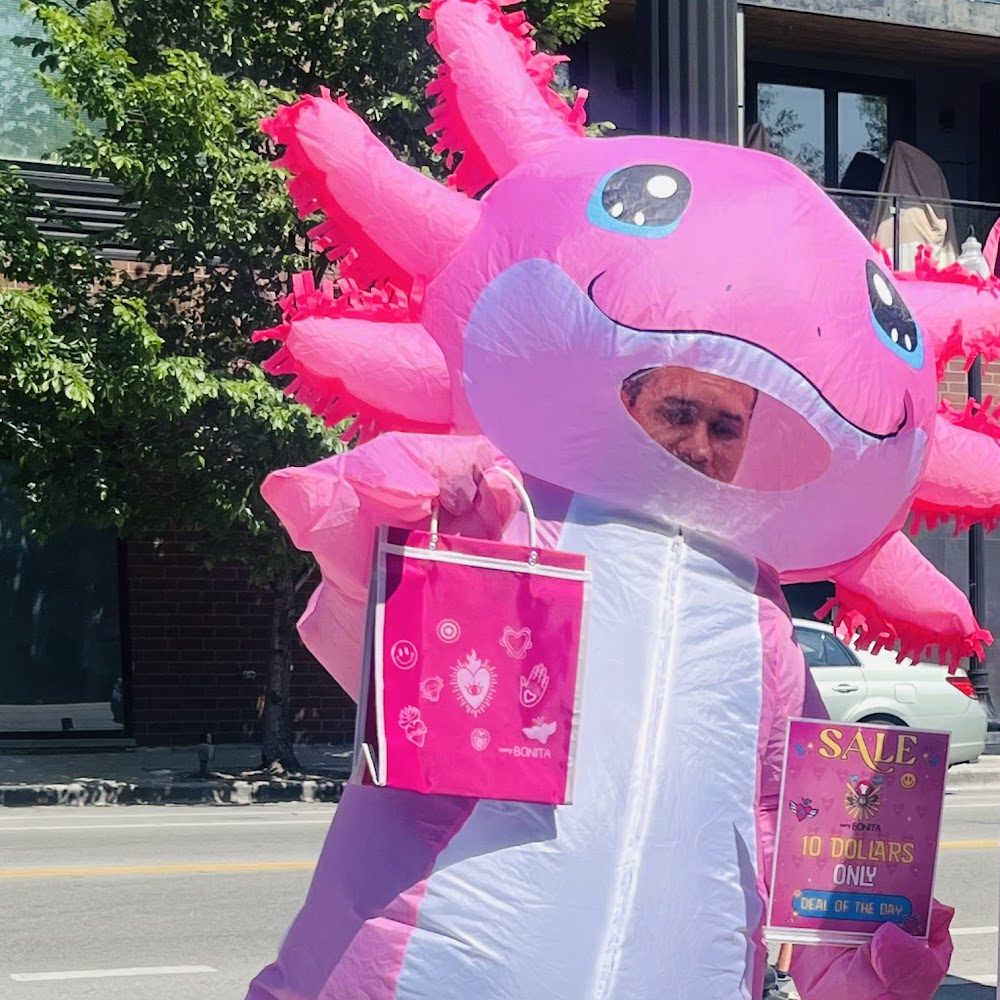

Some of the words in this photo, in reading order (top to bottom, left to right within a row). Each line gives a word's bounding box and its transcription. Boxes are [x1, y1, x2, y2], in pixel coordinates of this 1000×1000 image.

[514, 745, 552, 759] BONITA
[818, 728, 918, 773] SALE
[852, 821, 881, 833] BONITA
[801, 835, 822, 857] 10
[831, 836, 916, 863] DOLLARS
[833, 863, 877, 887] ONLY
[800, 897, 829, 912] DEAL
[834, 900, 849, 913] OF
[855, 901, 875, 915] THE
[880, 903, 904, 917] DAY
